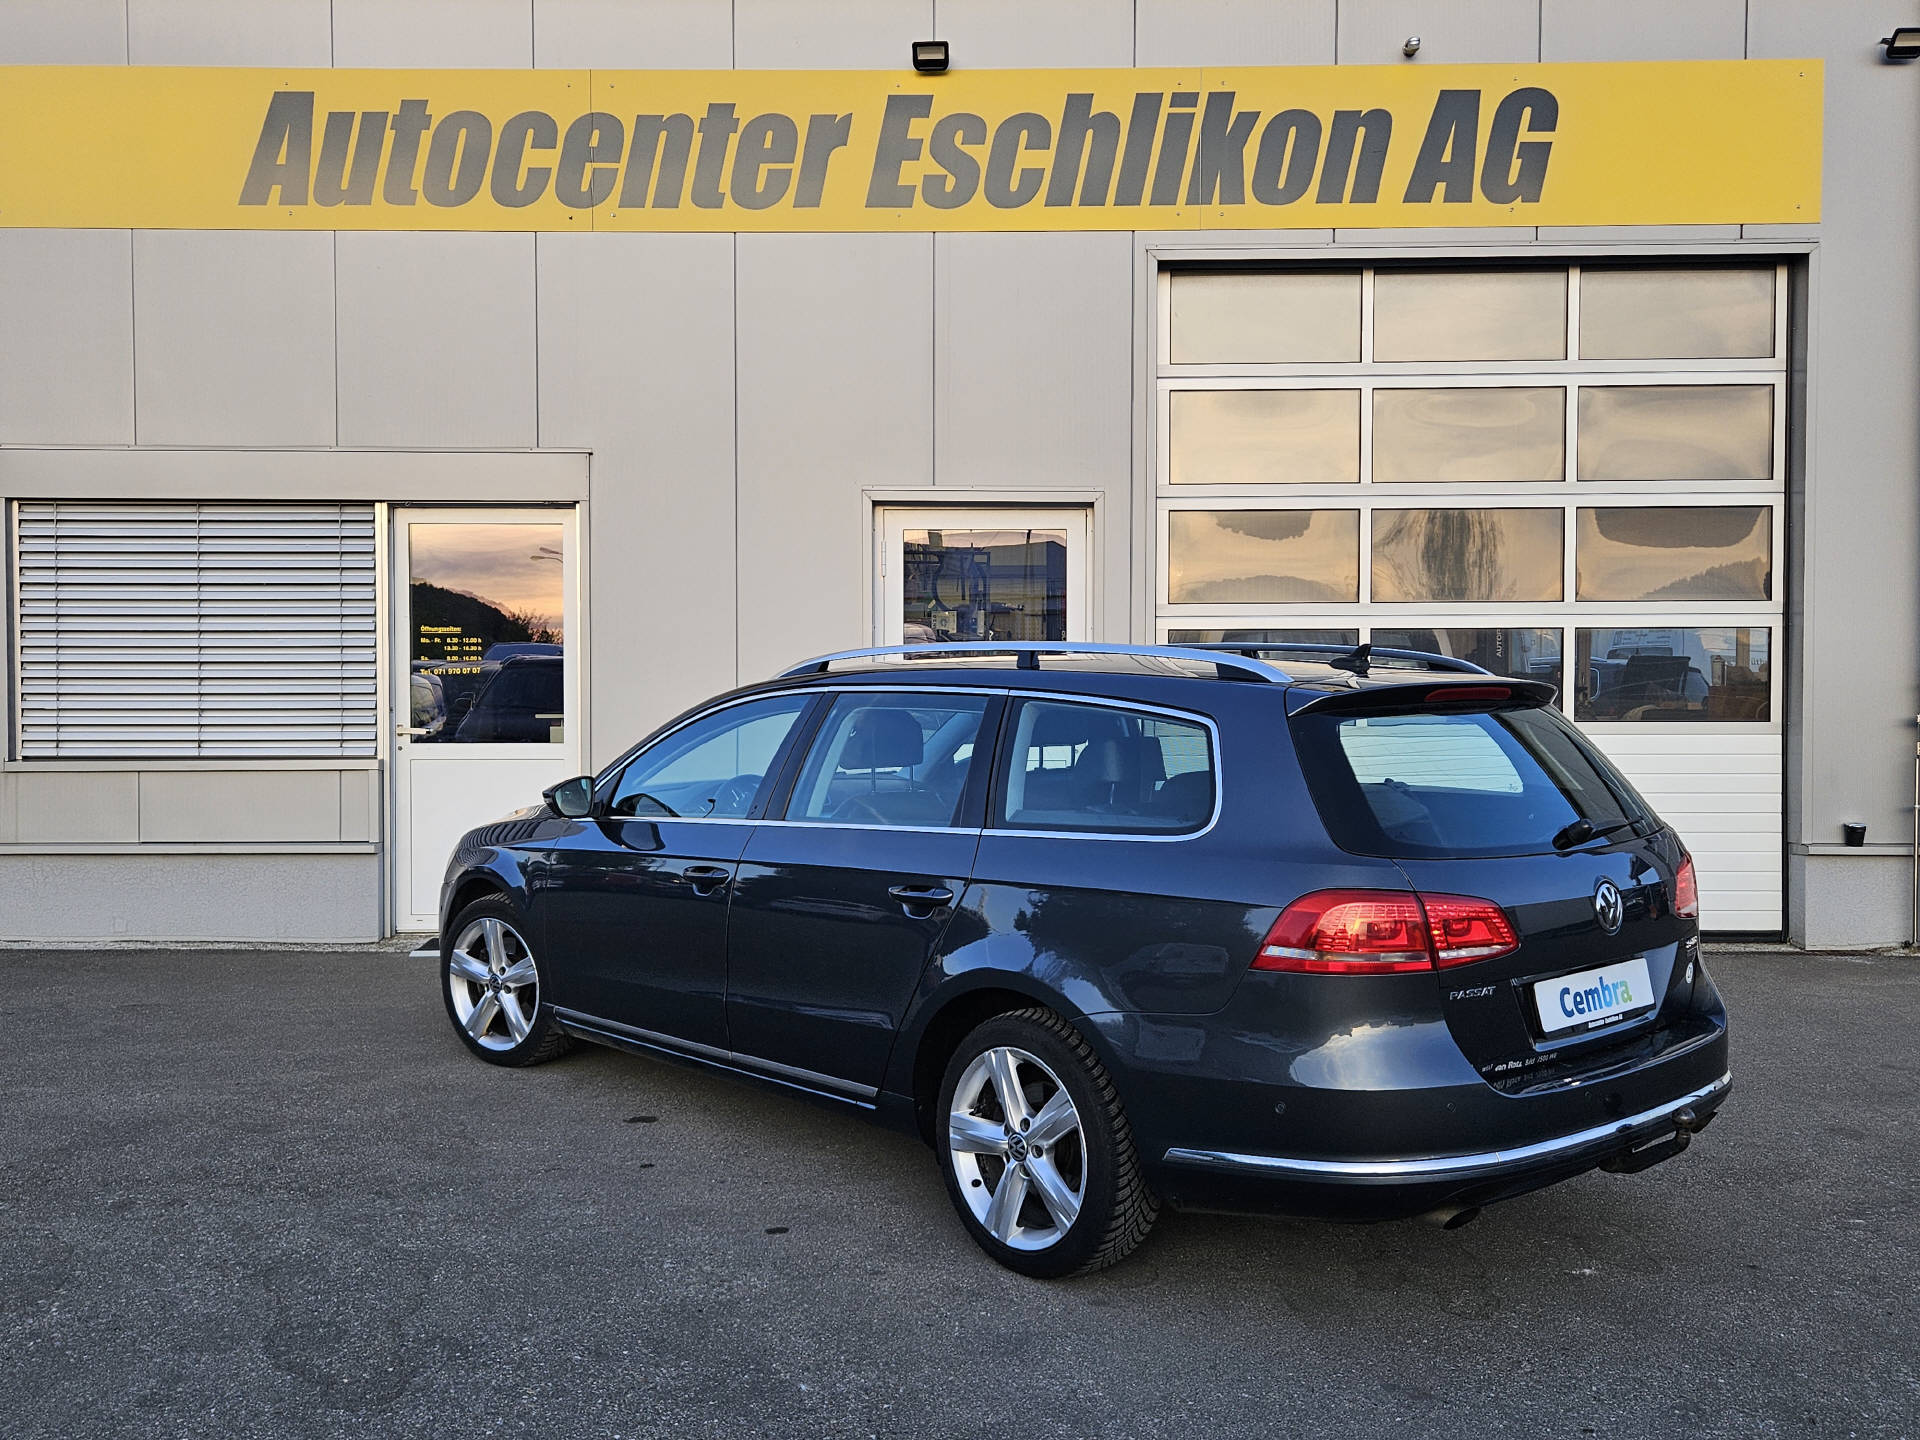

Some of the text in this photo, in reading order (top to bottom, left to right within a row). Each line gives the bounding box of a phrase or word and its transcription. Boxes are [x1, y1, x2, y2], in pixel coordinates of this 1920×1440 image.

[238, 87, 1560, 210] Autocenter Eschlikon AG
[447, 667, 461, 675] 970
[462, 667, 471, 675] 07
[471, 666, 481, 675] 07
[1450, 985, 1497, 1001] PASSAT
[1559, 976, 1633, 1018] Cembra
